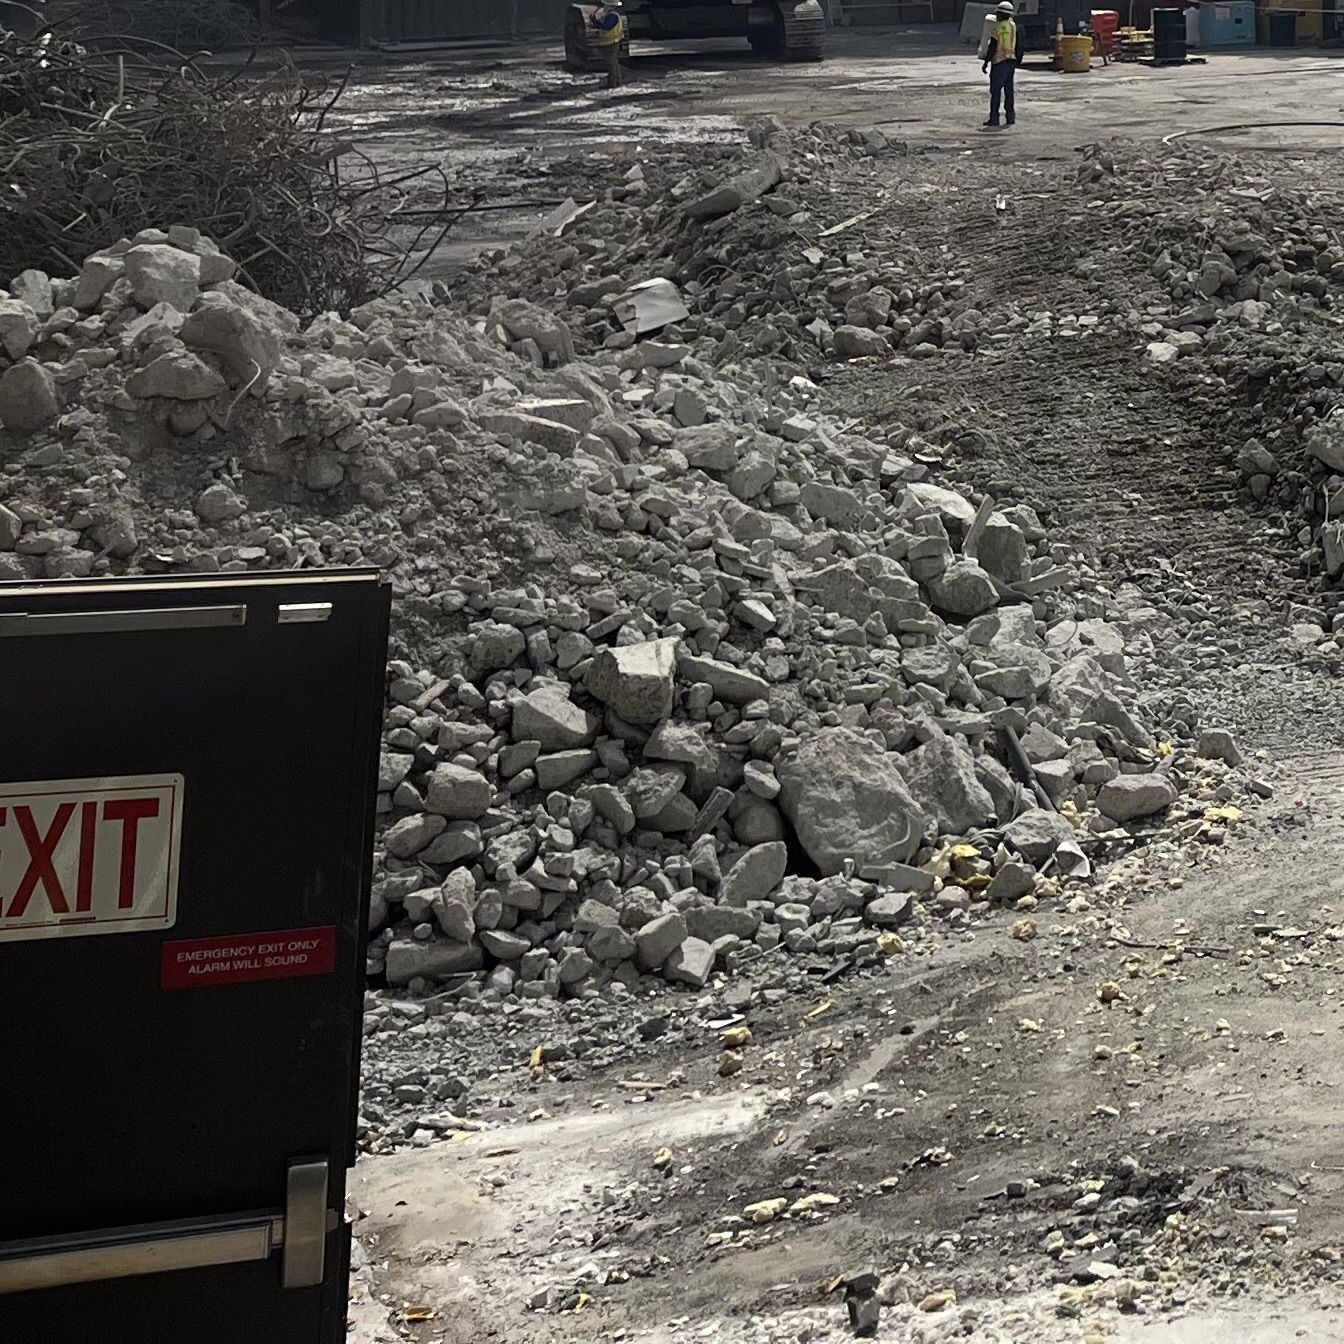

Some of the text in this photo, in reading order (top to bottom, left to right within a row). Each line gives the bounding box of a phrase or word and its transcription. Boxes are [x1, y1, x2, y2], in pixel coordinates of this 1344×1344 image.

[177, 939, 320, 962] EMERGENCY EXIT ONLY
[188, 954, 308, 975] ALARM WILL SOUND
